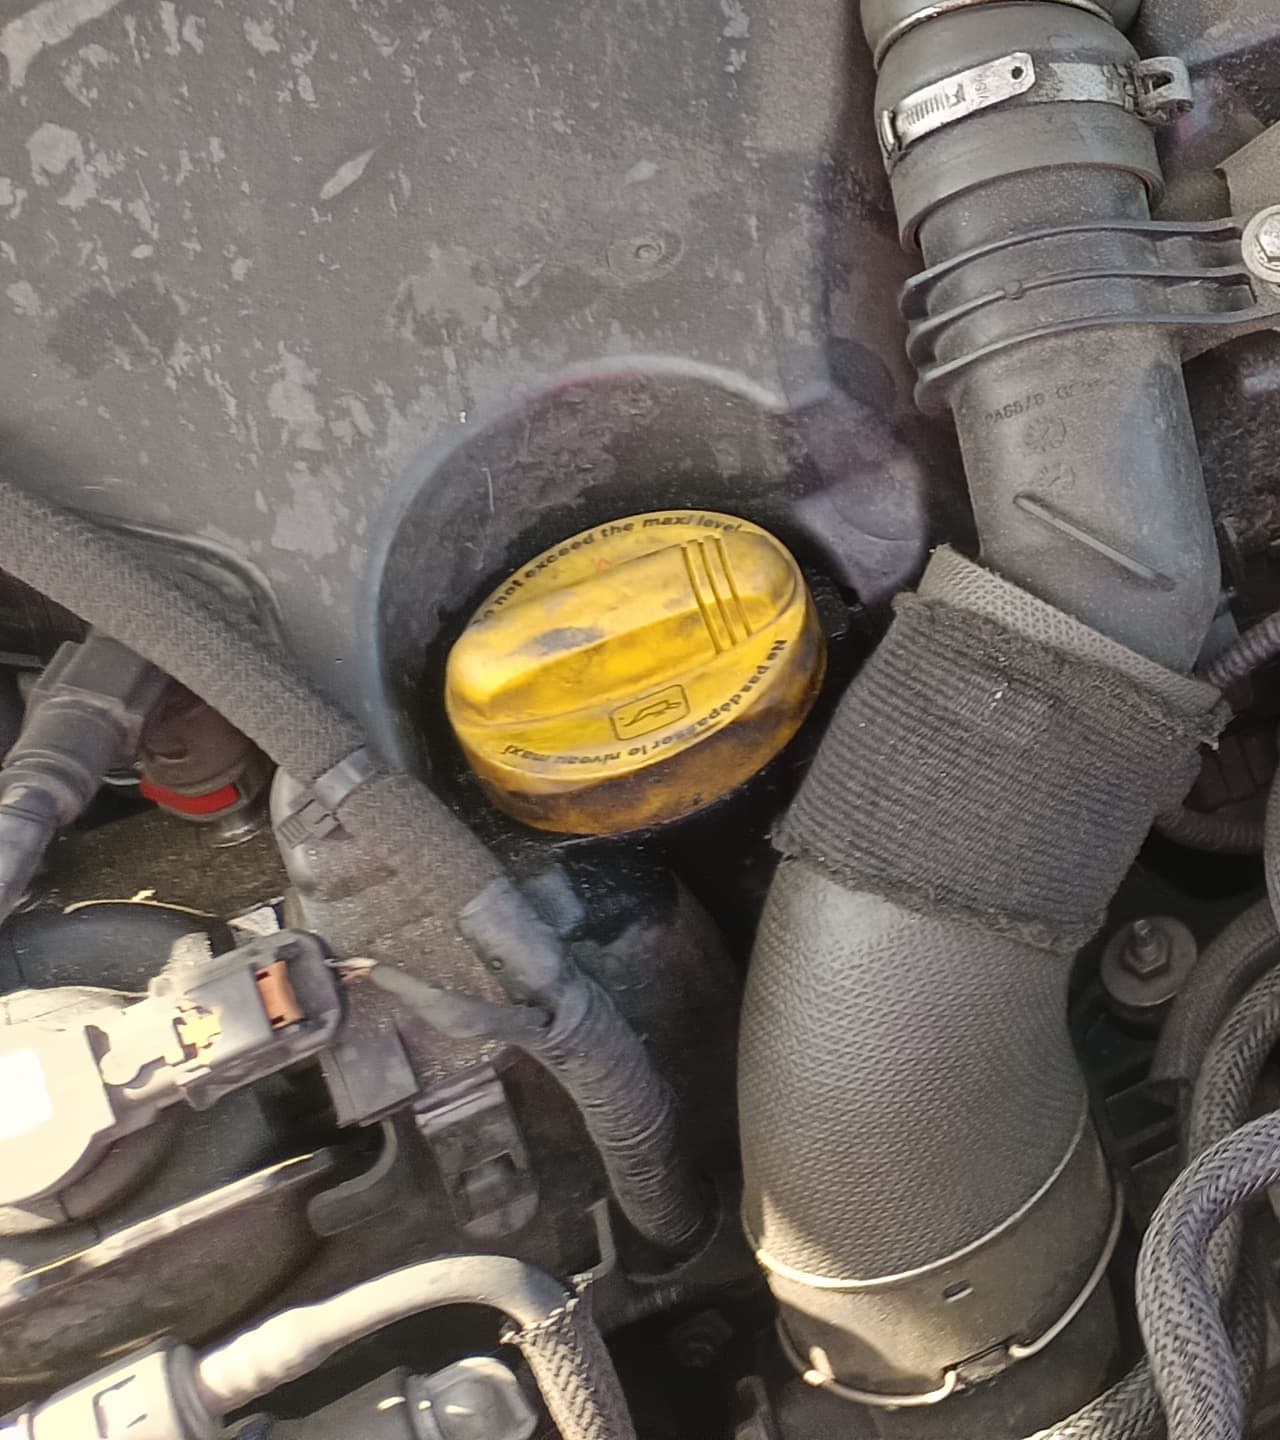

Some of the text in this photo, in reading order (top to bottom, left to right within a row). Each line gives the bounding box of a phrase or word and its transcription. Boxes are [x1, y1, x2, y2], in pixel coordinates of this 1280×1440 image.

[494, 579, 524, 606] not
[524, 533, 595, 579] exceed
[601, 521, 635, 538] the
[642, 513, 694, 528] maxi
[697, 514, 743, 531] level
[767, 639, 788, 661] Ne
[627, 745, 648, 756] le
